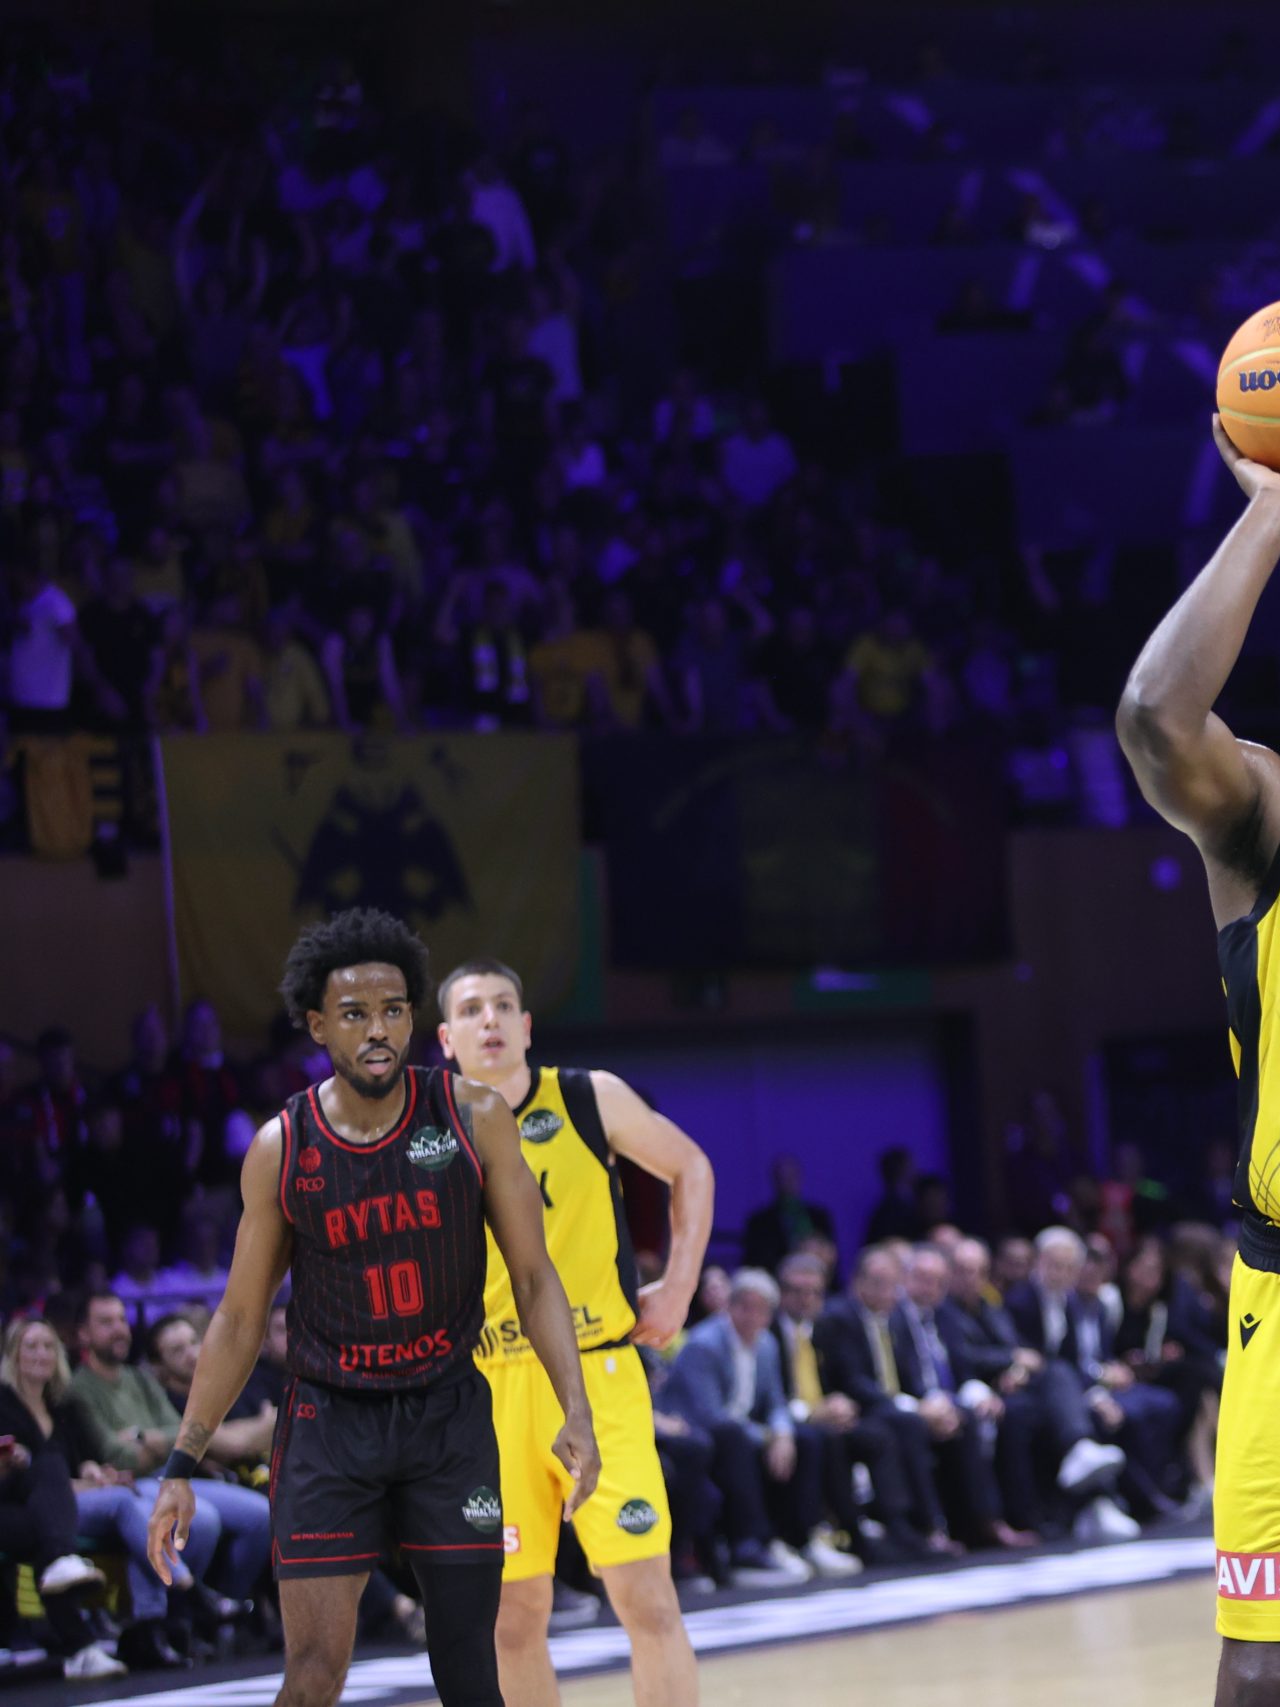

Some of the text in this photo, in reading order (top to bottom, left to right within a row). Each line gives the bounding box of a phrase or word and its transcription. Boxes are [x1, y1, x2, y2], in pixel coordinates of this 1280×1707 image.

[324, 1189, 442, 1249] RYTAS
[363, 1260, 424, 1320] 10
[338, 1328, 453, 1372] UTENOS
